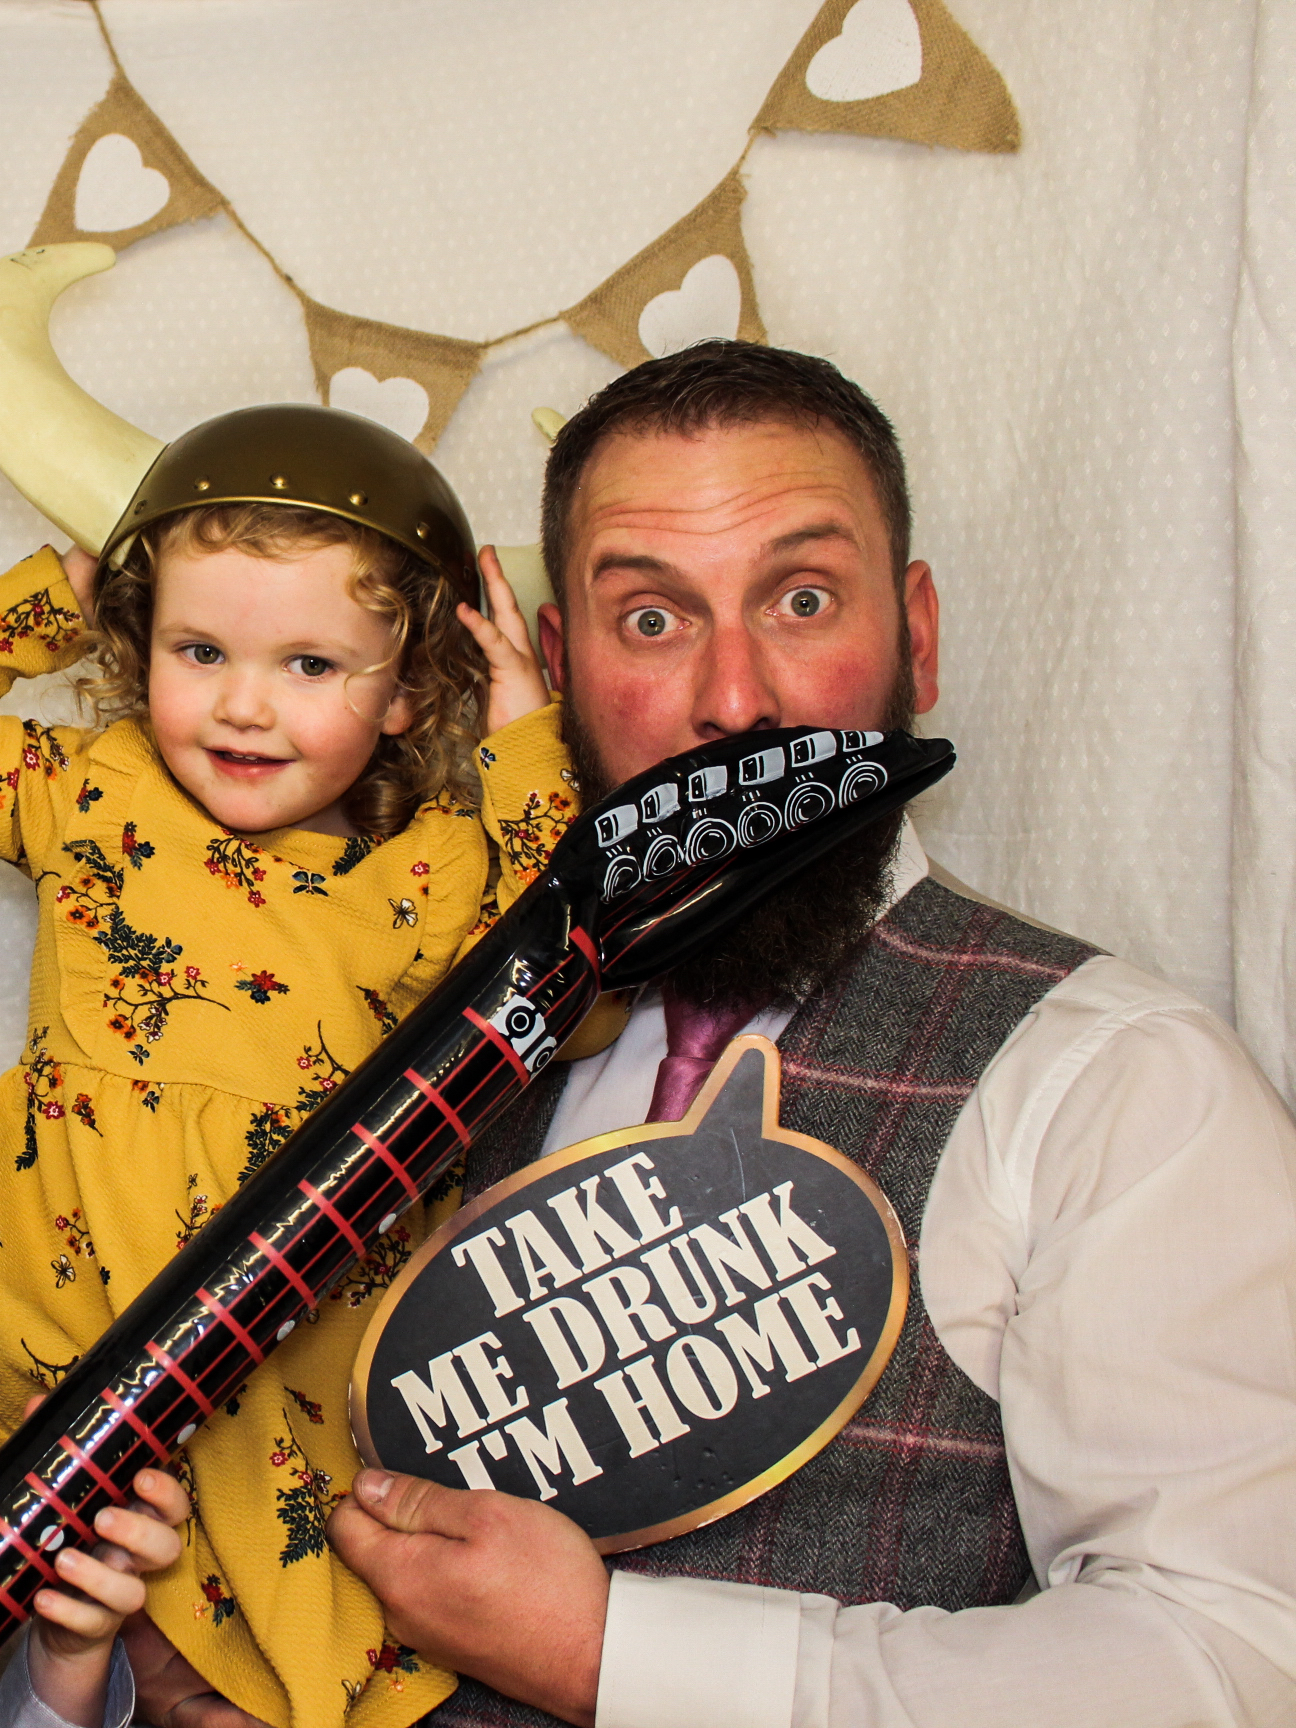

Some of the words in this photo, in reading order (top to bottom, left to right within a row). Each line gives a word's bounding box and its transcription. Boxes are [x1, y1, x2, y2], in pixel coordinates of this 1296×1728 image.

[390, 1331, 531, 1455] ME
[522, 1180, 837, 1391] DRUNK
[451, 1151, 684, 1319] TAKE
[447, 1397, 604, 1502] I'M
[593, 1274, 862, 1459] HOME
